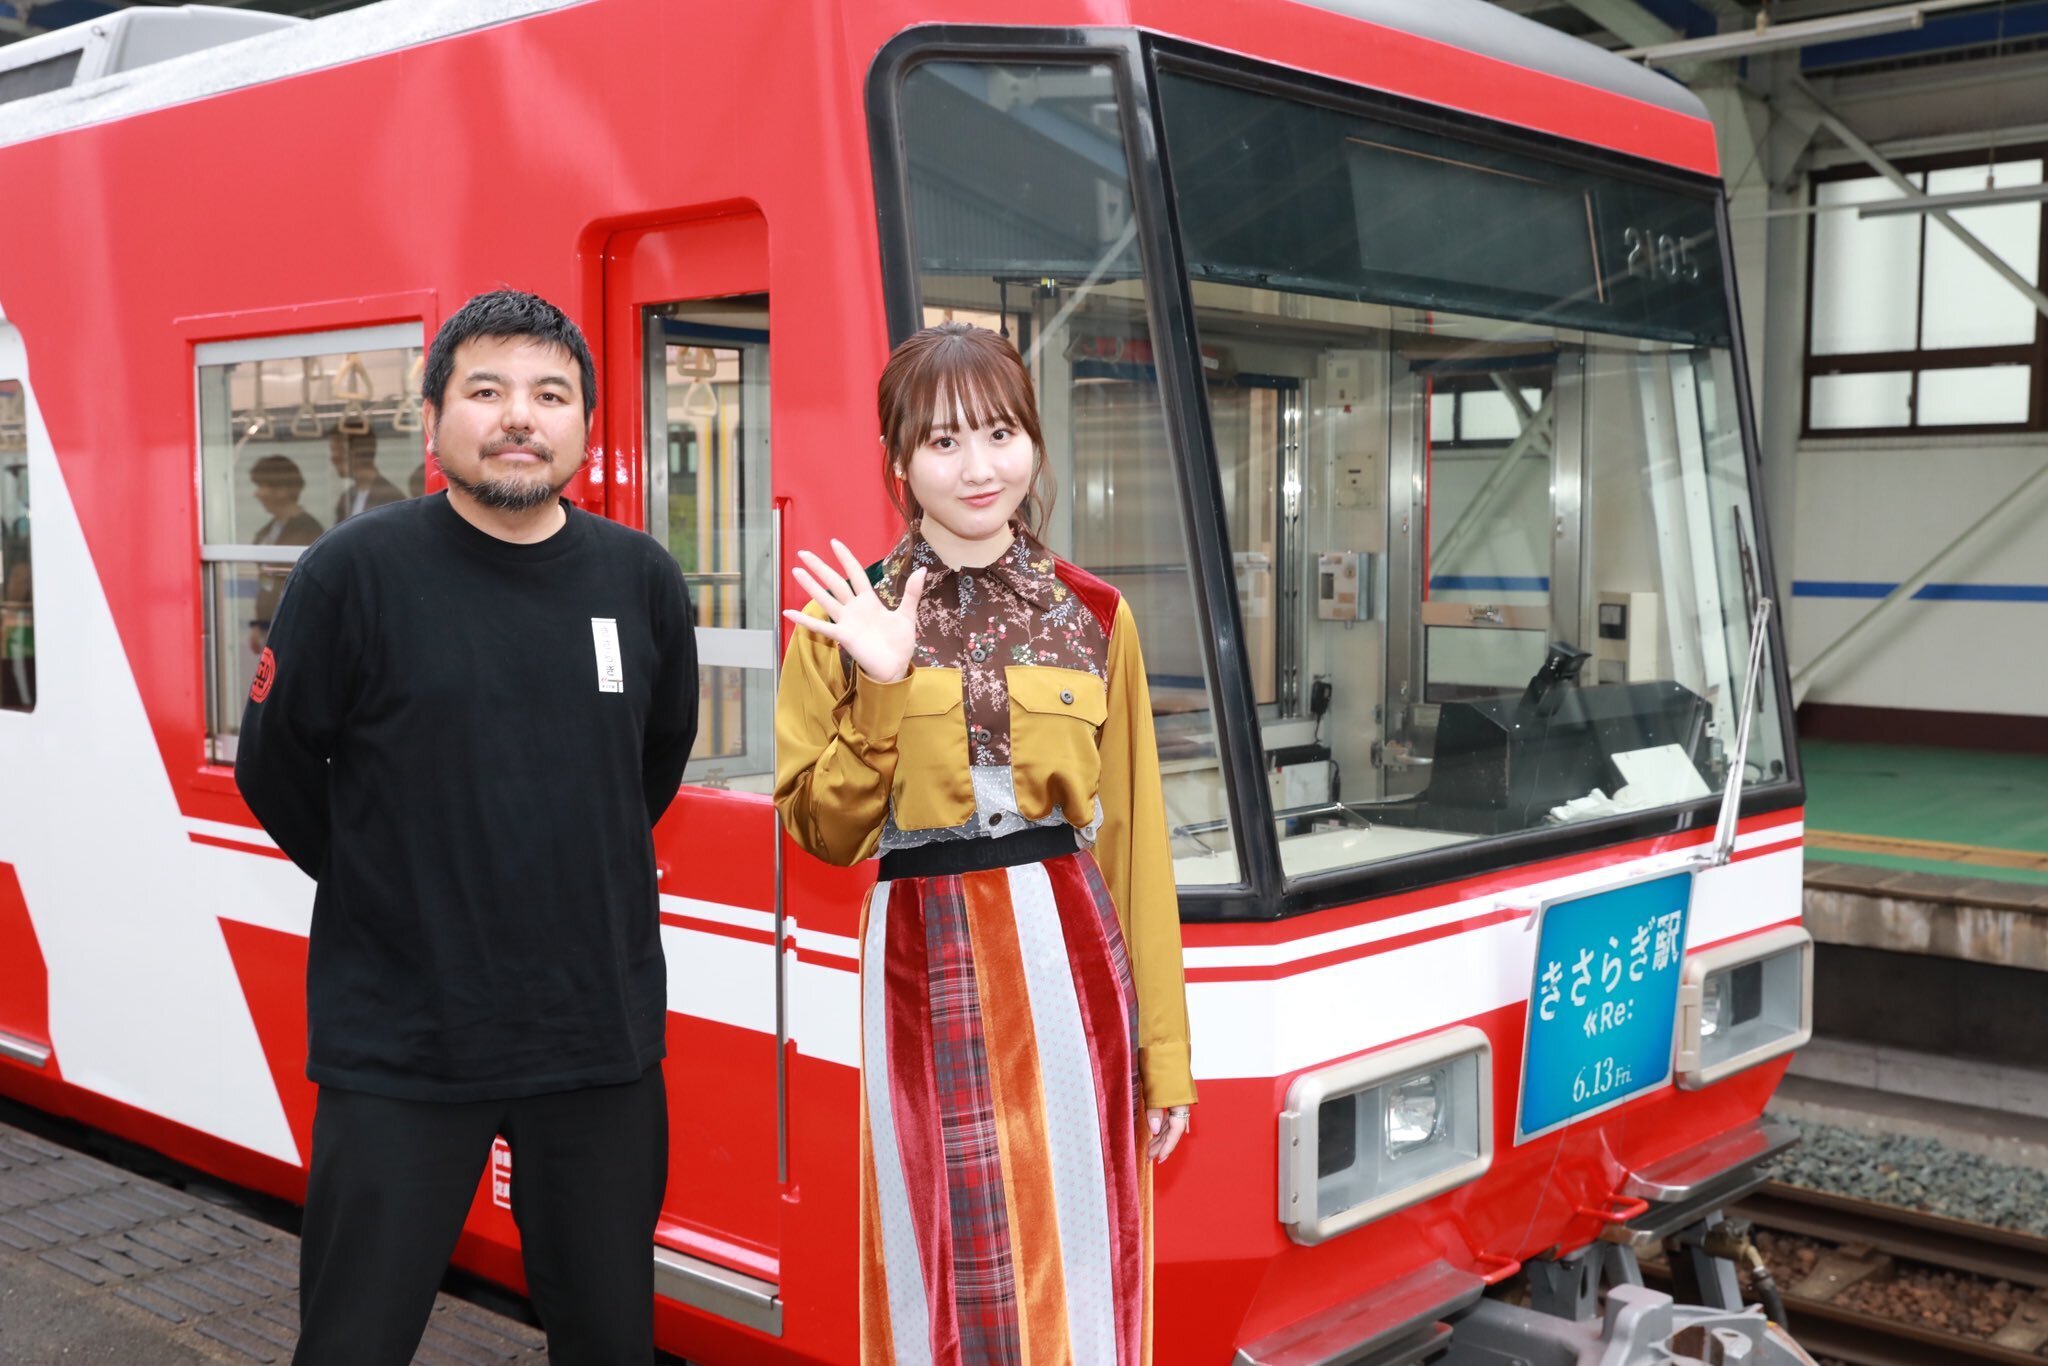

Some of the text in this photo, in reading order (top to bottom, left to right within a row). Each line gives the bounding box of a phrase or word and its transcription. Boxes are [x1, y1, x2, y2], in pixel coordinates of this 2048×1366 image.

[1540, 910, 1681, 1021] きさらぎ駅
[1573, 1057, 1614, 1102] 6.13
